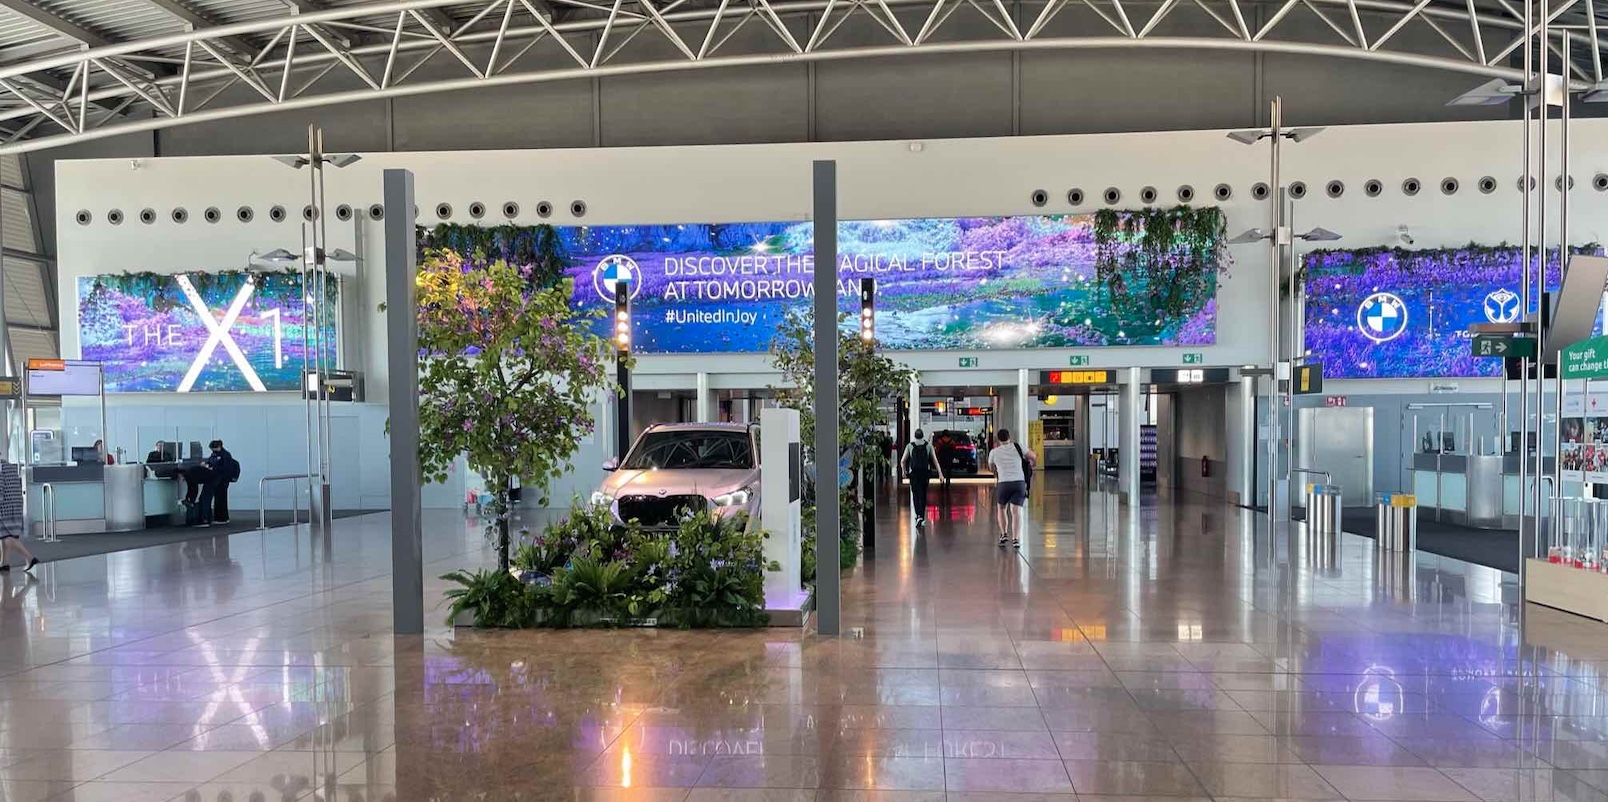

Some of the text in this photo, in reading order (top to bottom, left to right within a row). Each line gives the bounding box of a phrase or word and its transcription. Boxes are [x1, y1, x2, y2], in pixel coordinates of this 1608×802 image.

[599, 257, 636, 272] BMW
[664, 250, 1007, 276] DISCOVER THE AGICAL FOREST
[664, 278, 882, 300] AT TOMORROWAN.
[665, 308, 758, 325] #UnitedInJoy
[122, 274, 282, 393] THE X1
[1568, 347, 1596, 361] Your gift
[1568, 364, 1579, 372] can
[1580, 360, 1602, 373] change
